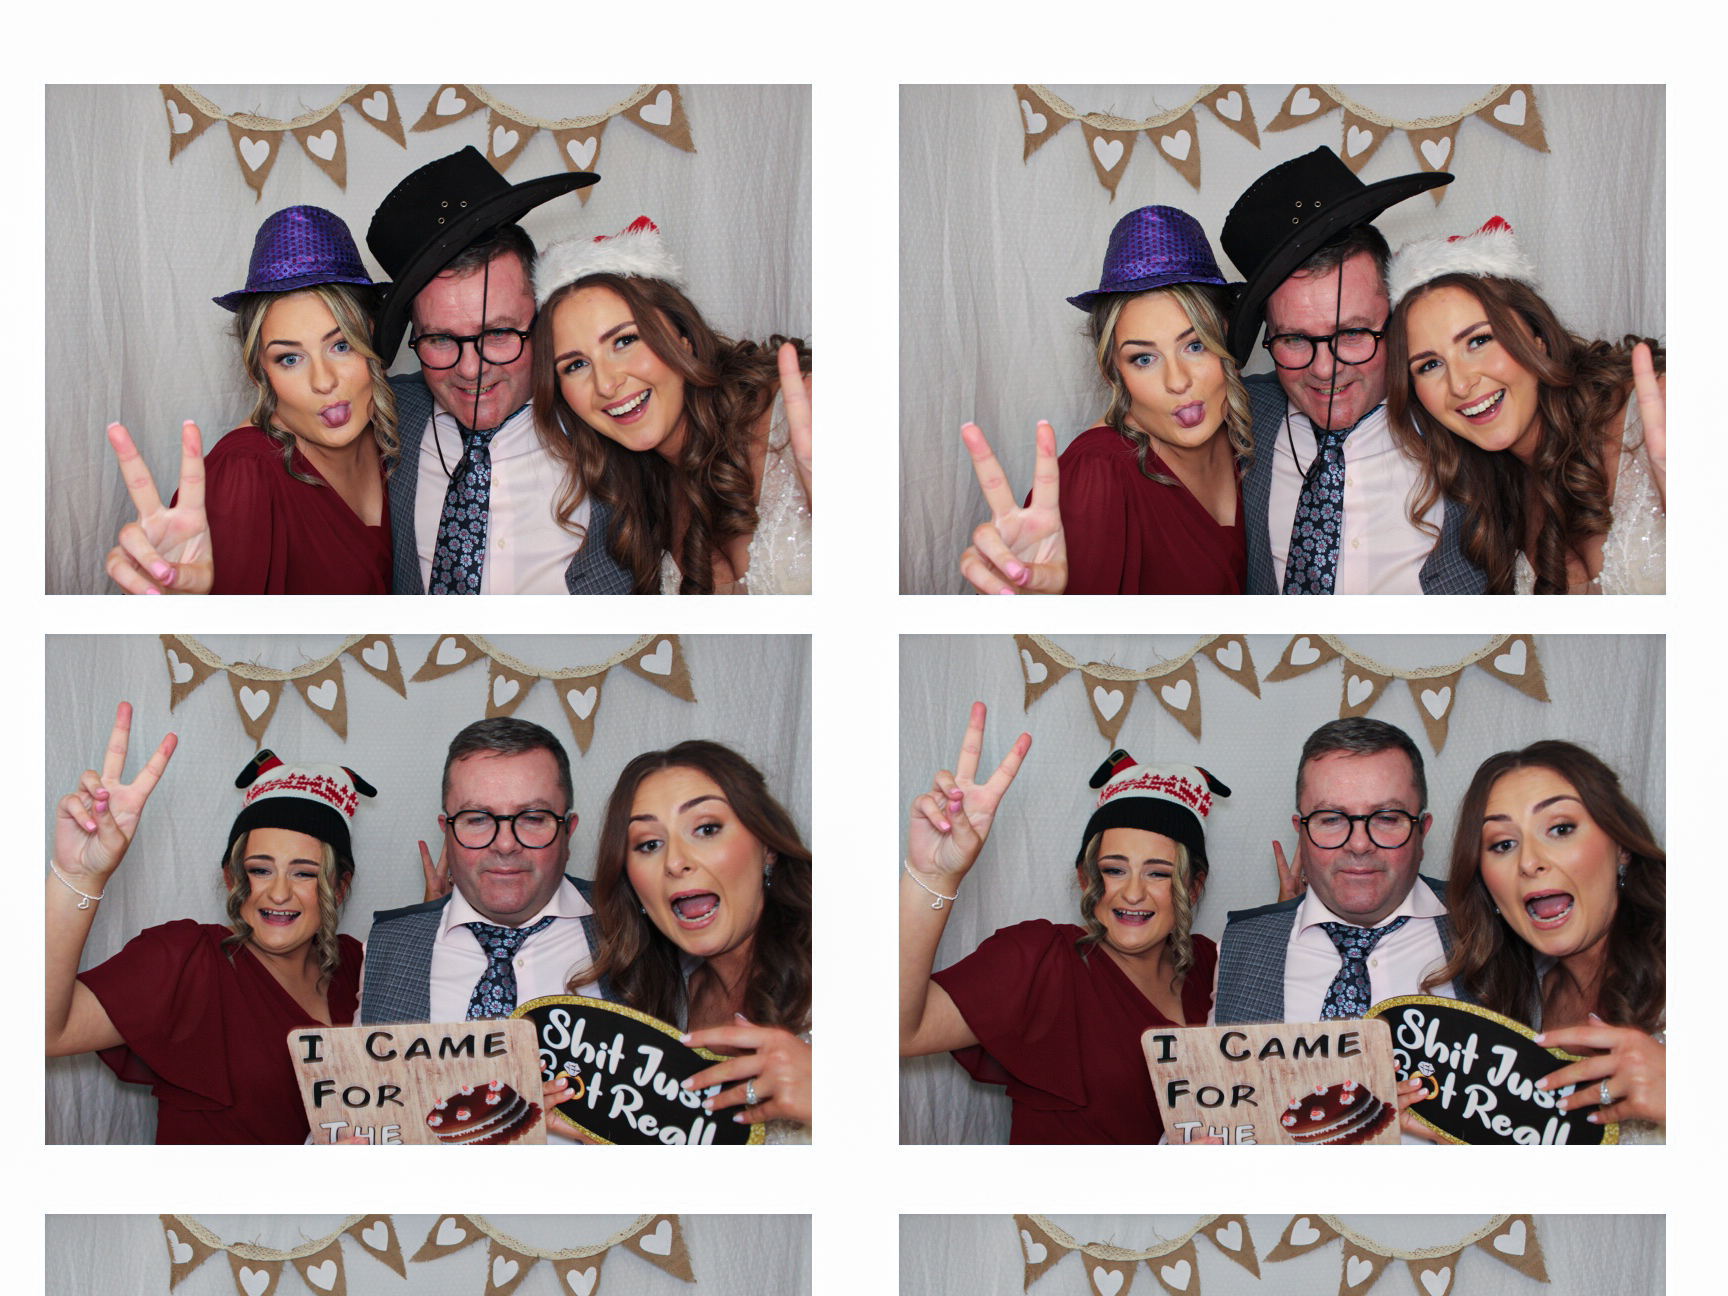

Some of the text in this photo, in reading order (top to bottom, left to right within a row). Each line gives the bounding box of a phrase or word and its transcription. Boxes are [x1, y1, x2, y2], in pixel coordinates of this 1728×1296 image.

[299, 1031, 508, 1064] I CAME
[542, 1008, 625, 1075] Shit
[1153, 1031, 1362, 1064] I CAME
[1396, 1008, 1479, 1075] Shit
[313, 1079, 405, 1109] FOR
[1167, 1079, 1259, 1109] FOR
